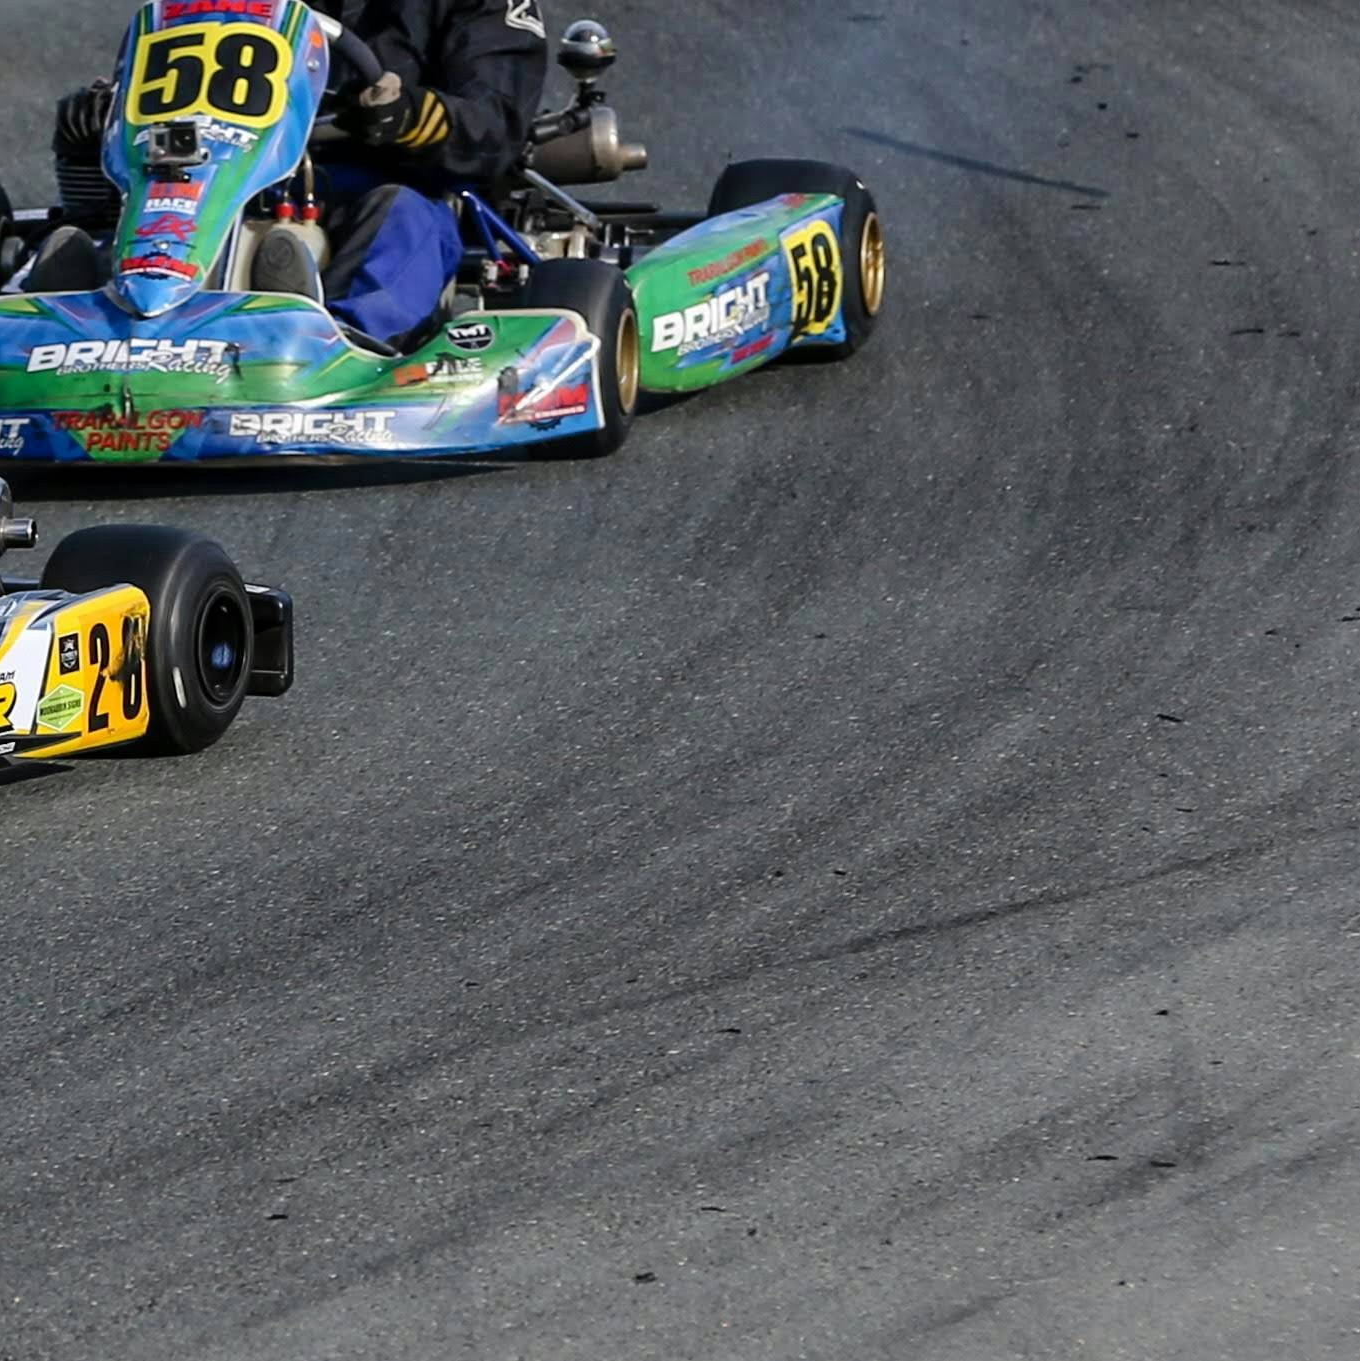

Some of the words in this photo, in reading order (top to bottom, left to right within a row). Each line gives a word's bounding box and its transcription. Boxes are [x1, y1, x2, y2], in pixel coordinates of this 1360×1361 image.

[138, 32, 278, 117] 58
[651, 272, 771, 352] BRIGHT
[790, 232, 837, 340] 58
[26, 338, 229, 374] BRIGHT
[85, 431, 172, 453] PAINTS
[231, 410, 396, 437] BRIGHT
